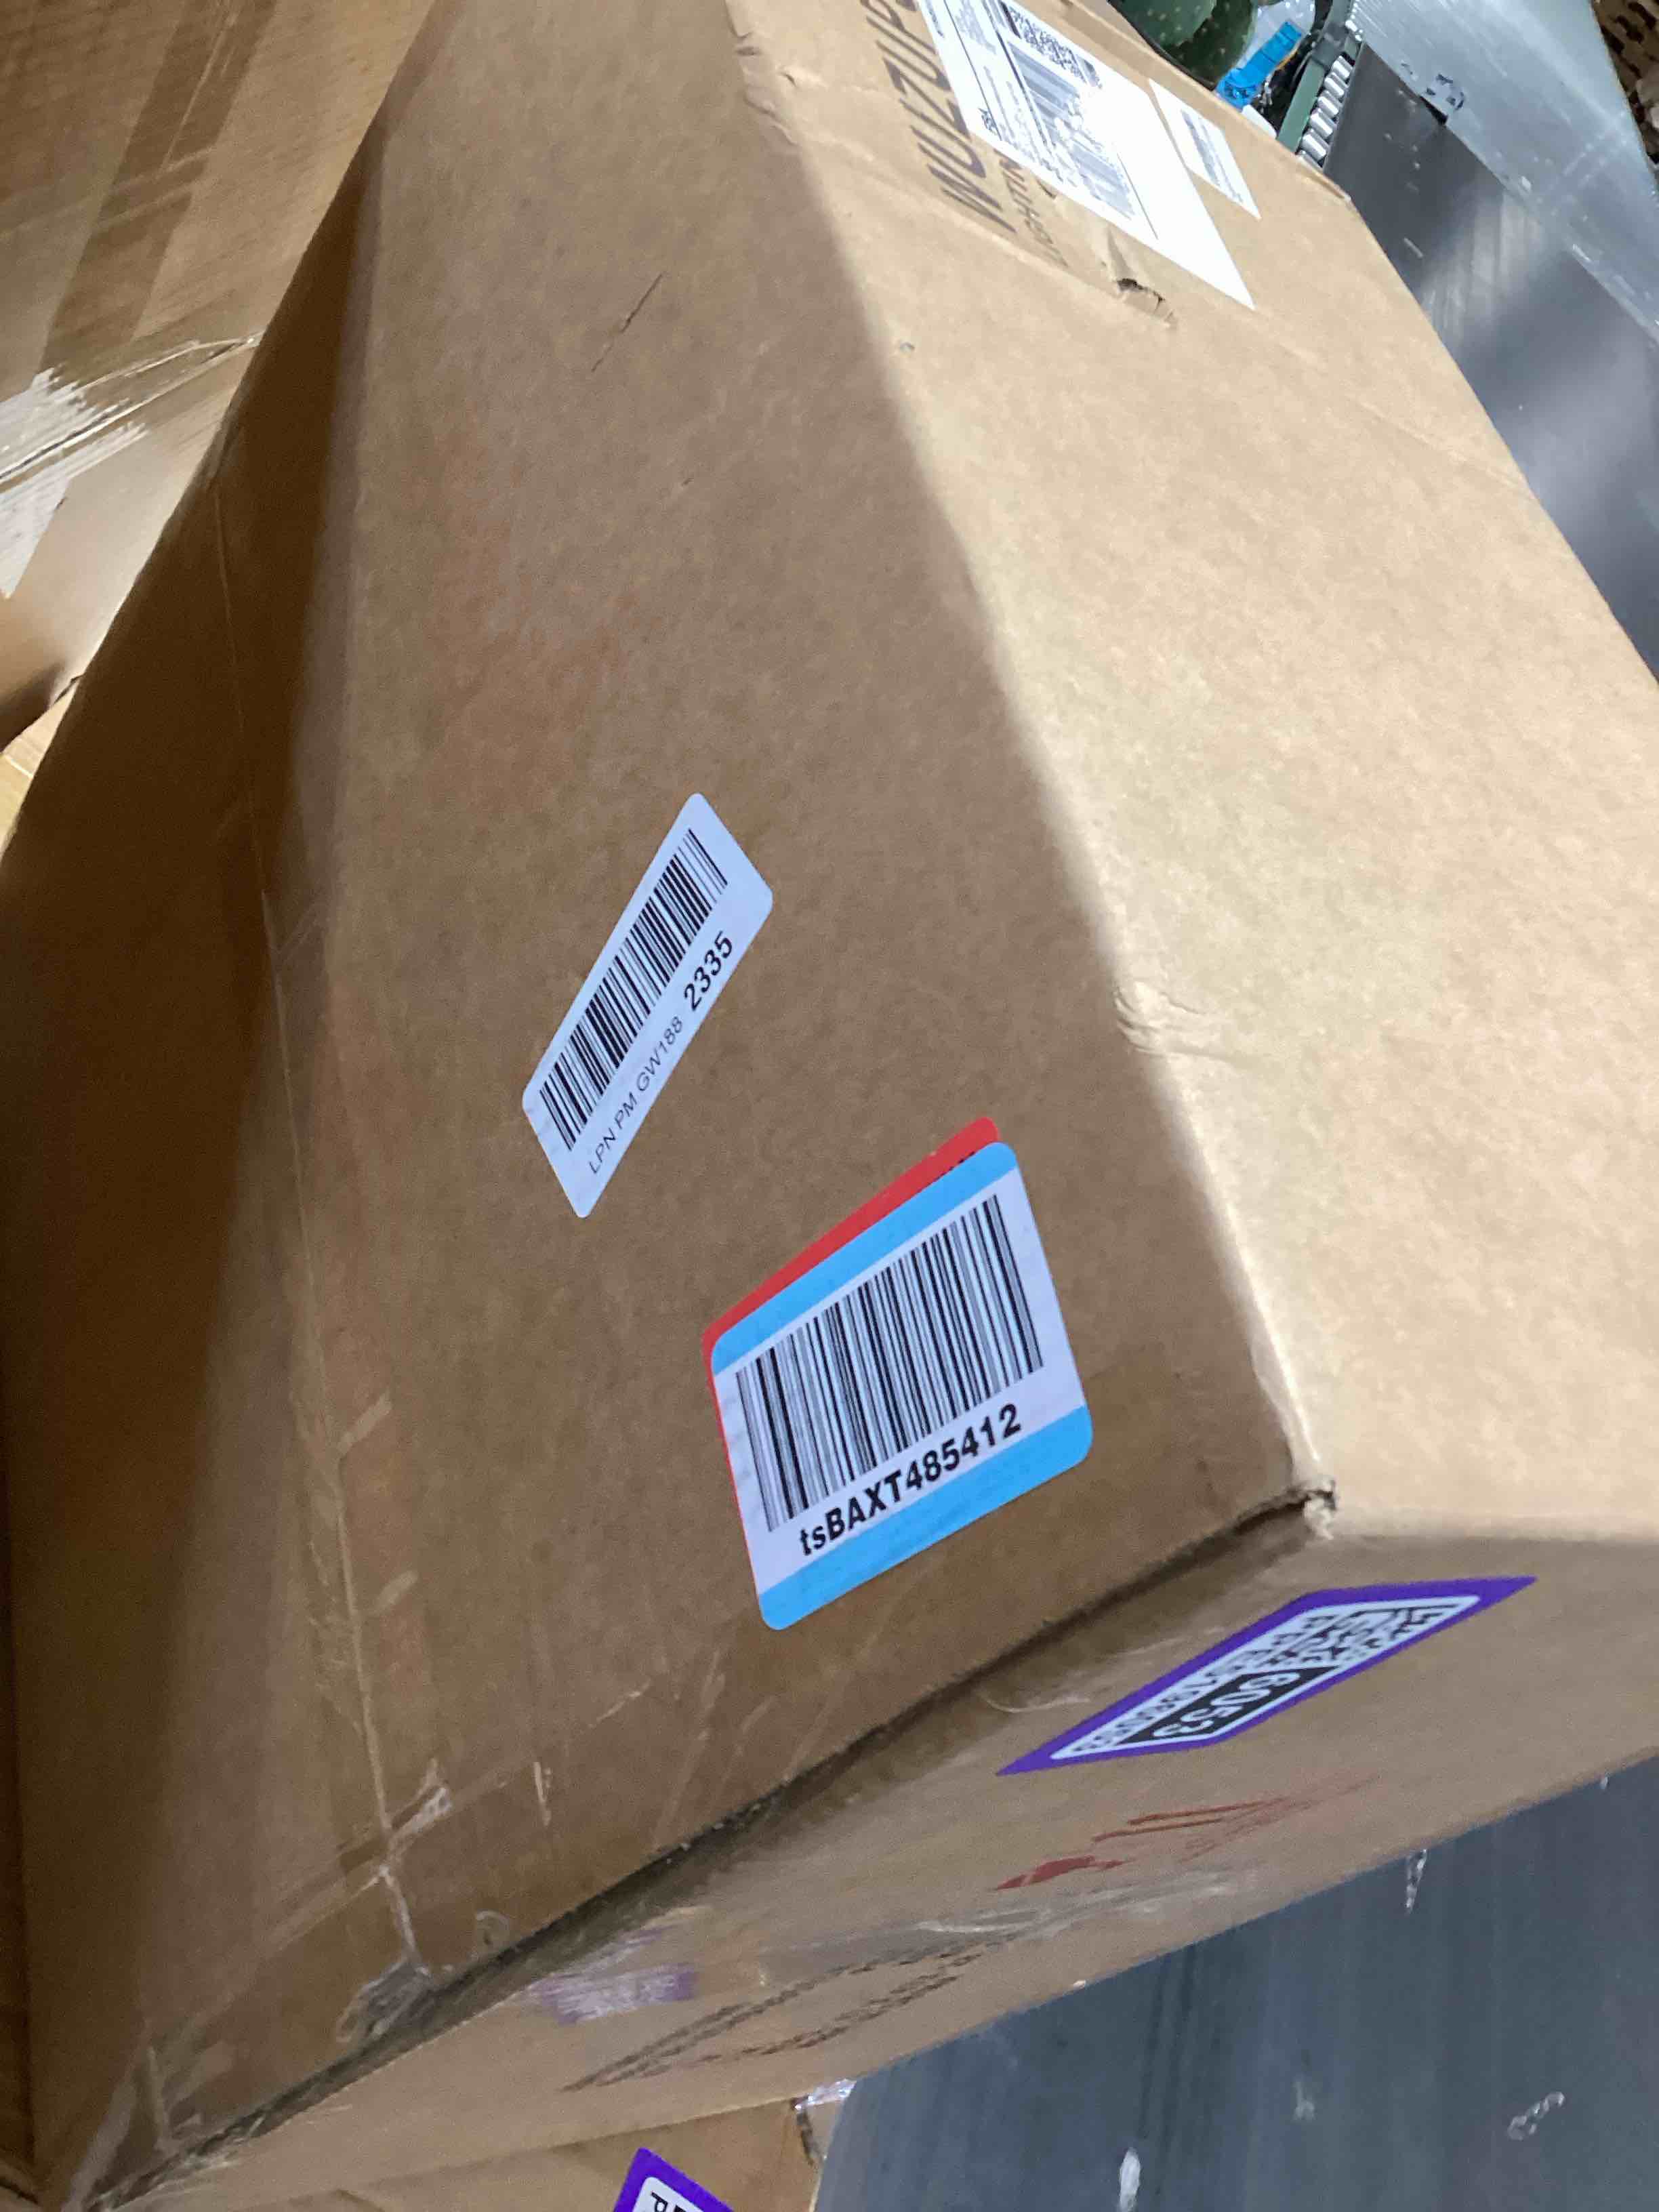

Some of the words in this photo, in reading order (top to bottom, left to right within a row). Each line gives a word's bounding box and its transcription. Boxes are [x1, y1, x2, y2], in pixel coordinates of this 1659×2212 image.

[588, 1128, 617, 1174] LPN
[615, 1092, 638, 1129] PM
[636, 1015, 684, 1091] GW188
[684, 930, 733, 1012] 2335
[799, 1404, 1021, 1555] tsBAXT485412
[1153, 1671, 1301, 1738] 6053
